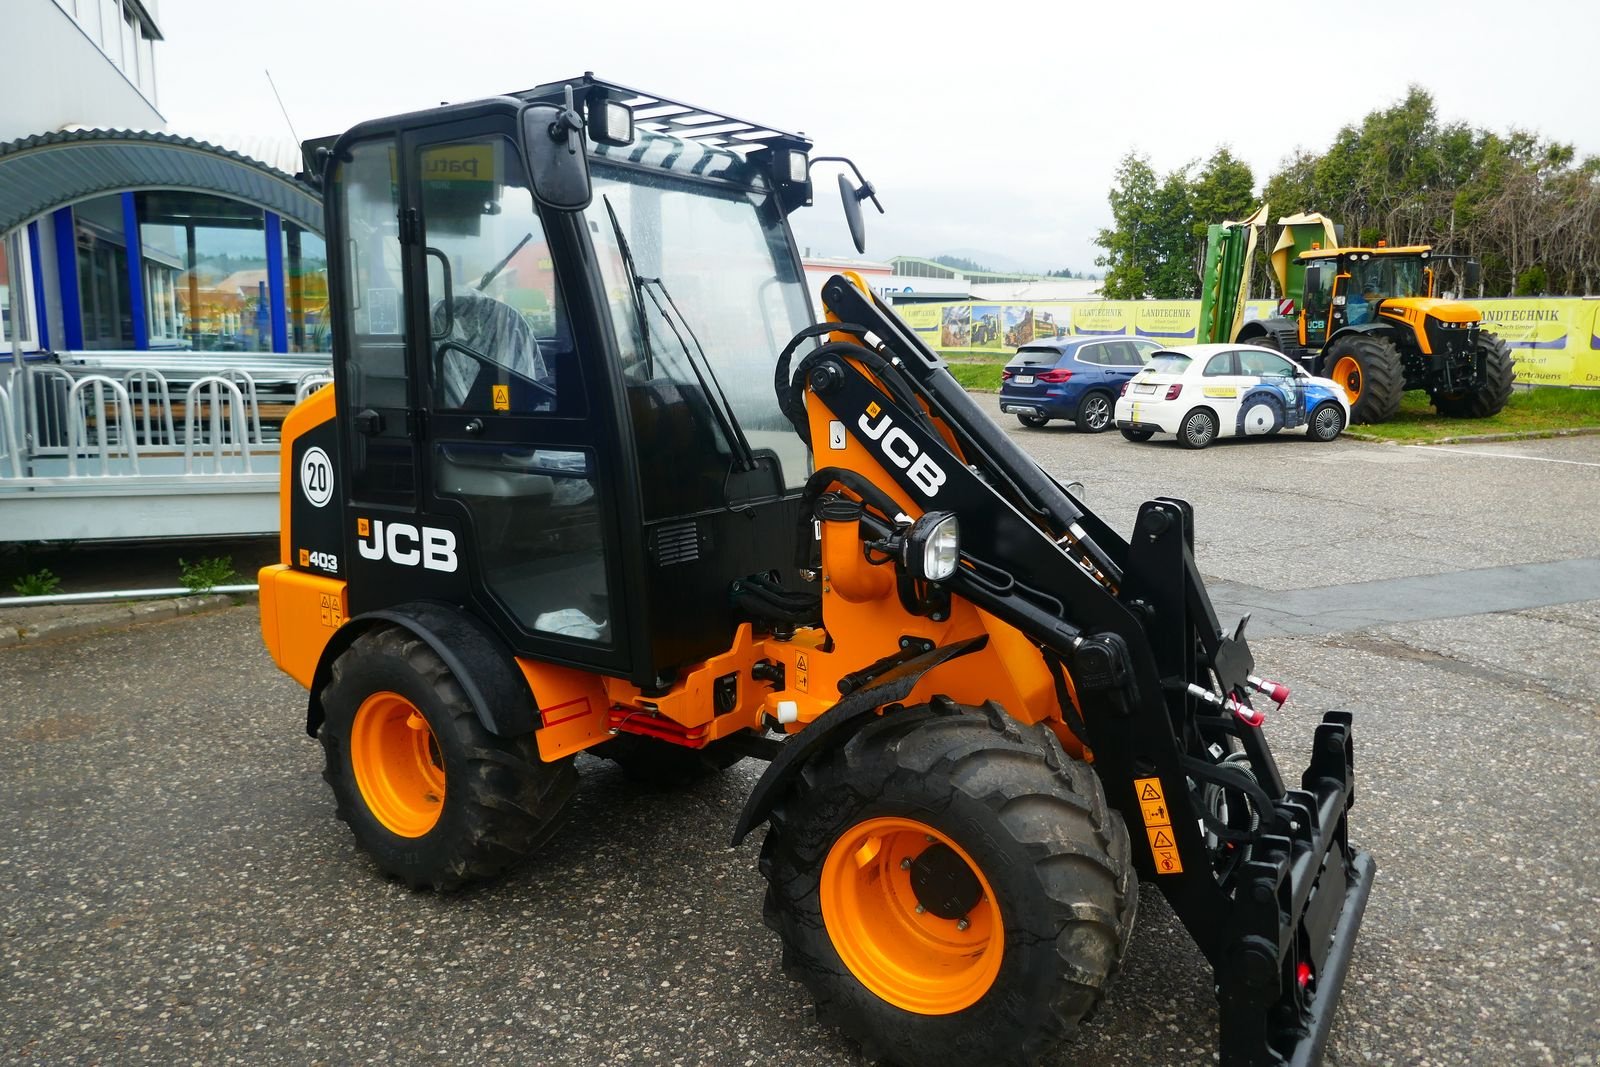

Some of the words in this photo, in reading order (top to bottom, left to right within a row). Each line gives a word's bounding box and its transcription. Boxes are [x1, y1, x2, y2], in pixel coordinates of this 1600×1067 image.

[1141, 308, 1191, 318] LANDTECHNIK
[1480, 309, 1560, 321] ANDTECHNIK
[858, 413, 947, 498] JCB
[308, 462, 327, 492] 20
[358, 519, 458, 573] JCB
[309, 551, 338, 570] 403
